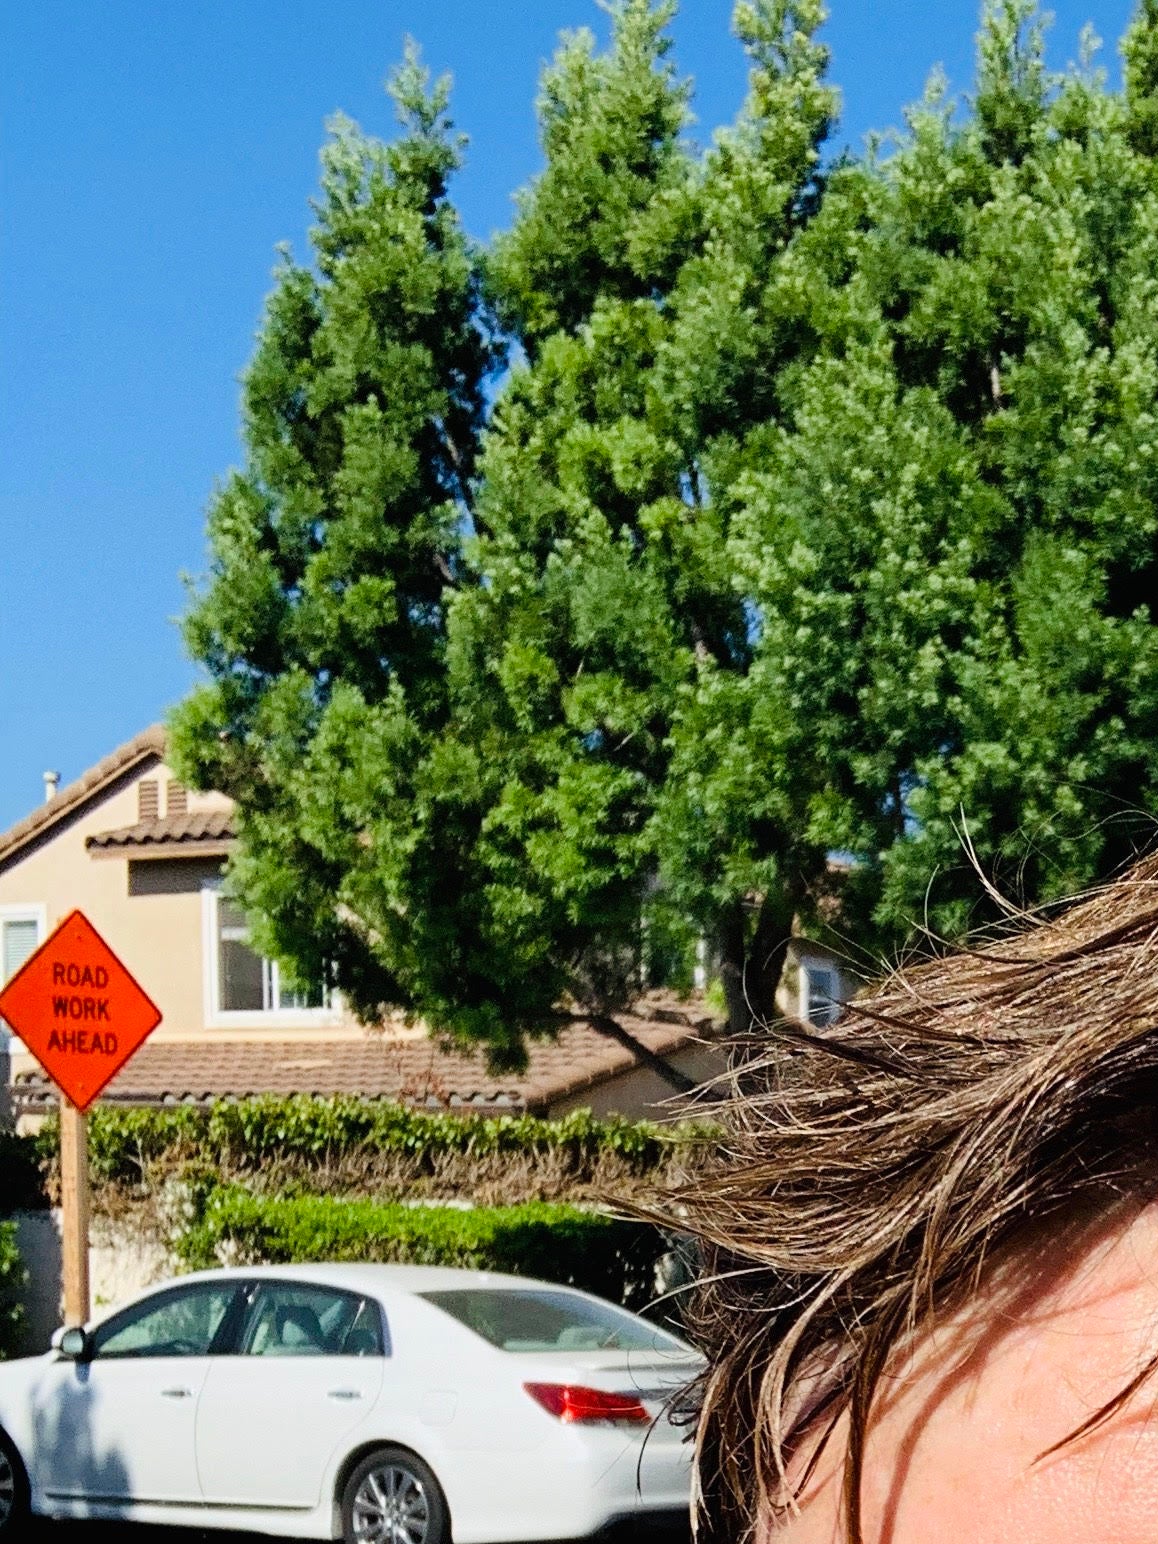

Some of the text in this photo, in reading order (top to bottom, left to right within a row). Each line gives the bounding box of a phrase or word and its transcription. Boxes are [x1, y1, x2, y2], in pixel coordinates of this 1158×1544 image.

[53, 961, 109, 989] ROAD
[52, 995, 111, 1021] WORK
[47, 1029, 118, 1056] AHEAD
